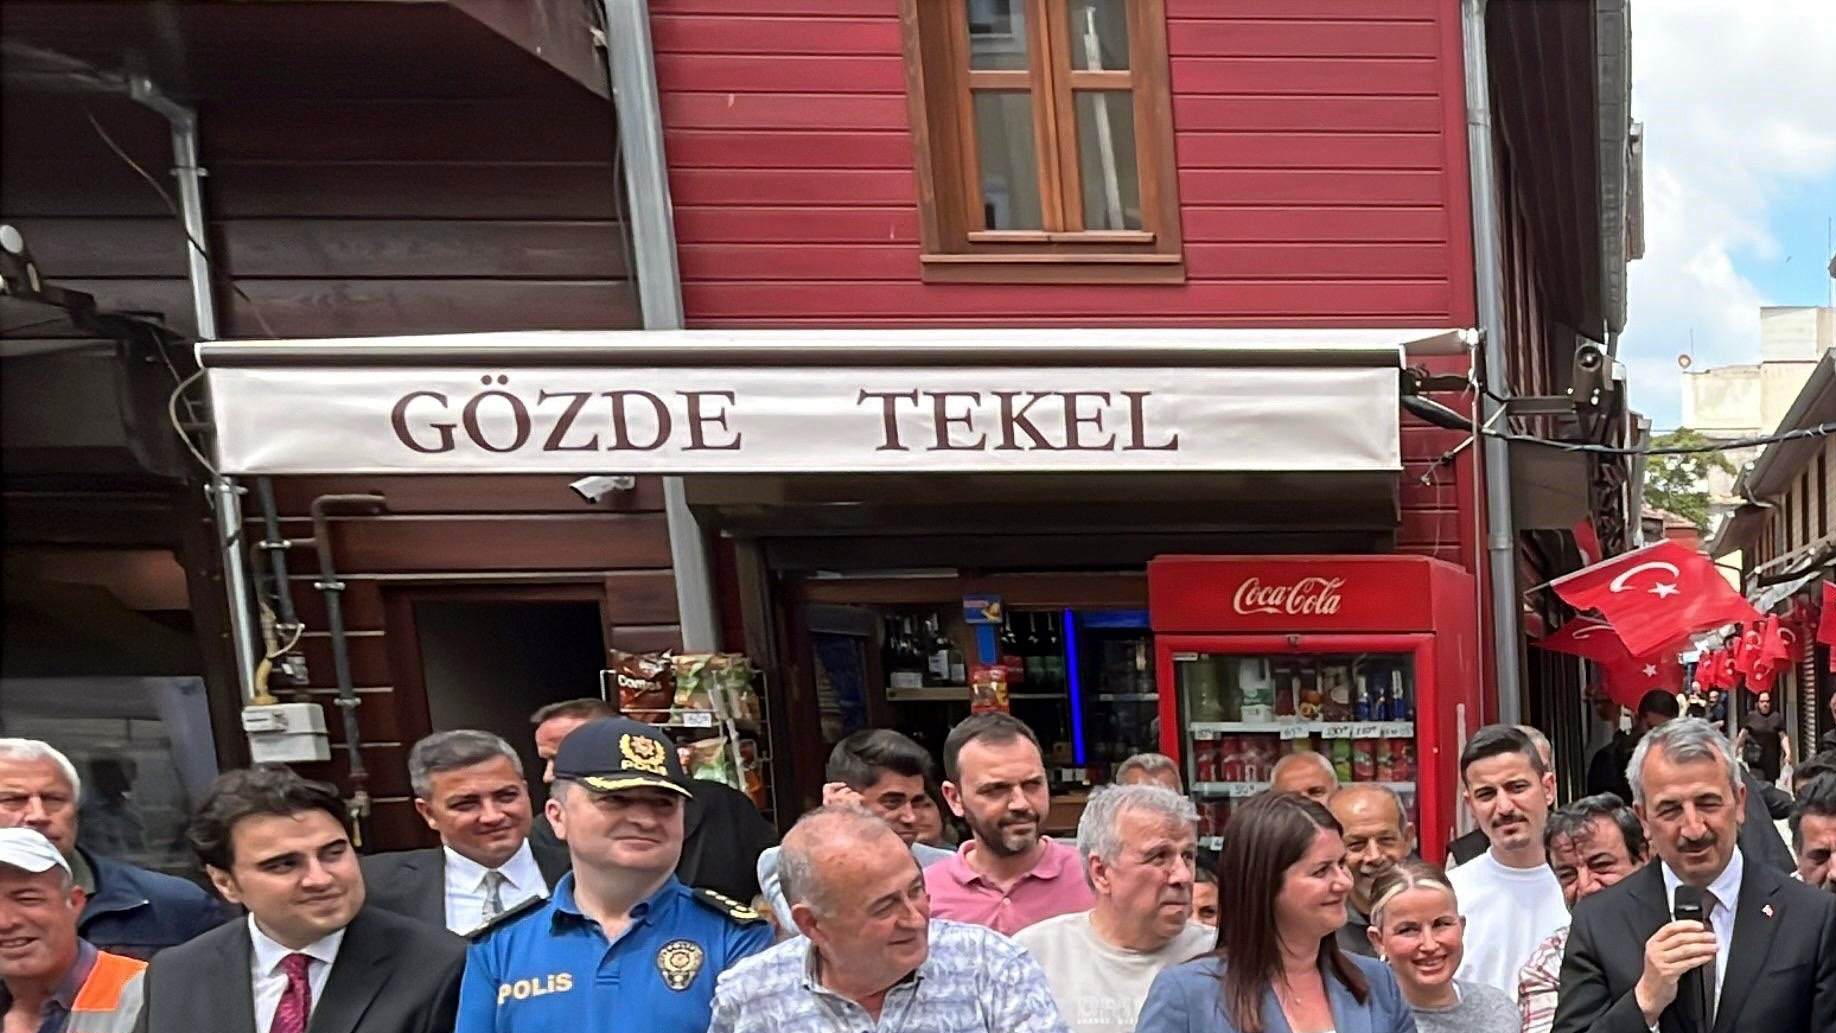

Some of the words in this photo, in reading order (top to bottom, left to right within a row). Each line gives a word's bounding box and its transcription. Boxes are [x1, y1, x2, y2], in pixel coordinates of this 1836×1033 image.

[390, 374, 742, 453] GÖZDE
[857, 388, 1178, 451] TEKEL
[1233, 576, 1347, 615] Coca-Cola
